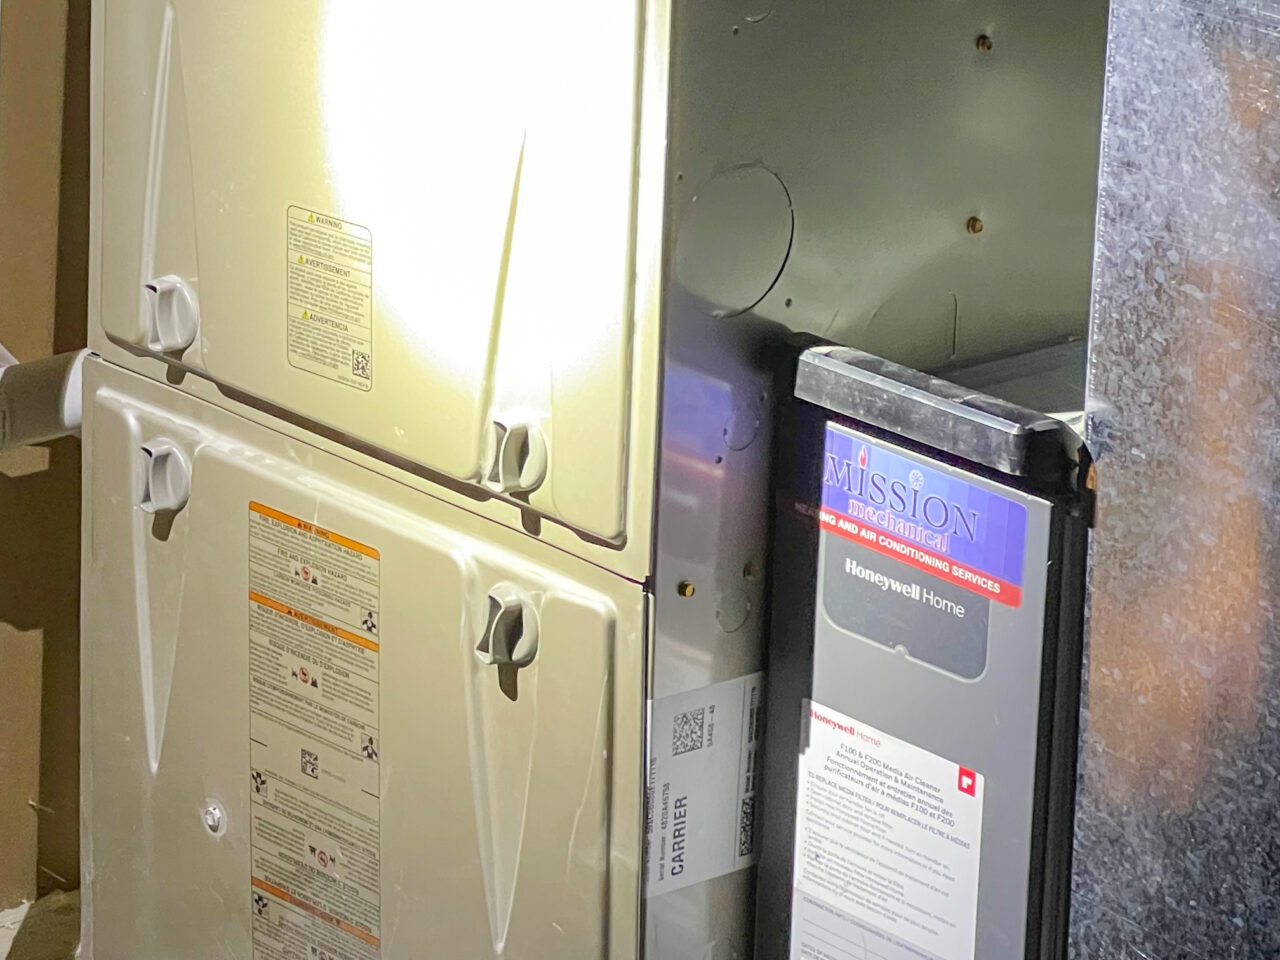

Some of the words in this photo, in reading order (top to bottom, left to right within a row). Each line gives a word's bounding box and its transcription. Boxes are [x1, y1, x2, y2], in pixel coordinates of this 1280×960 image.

[316, 216, 343, 230] WARNING
[305, 257, 351, 278] AVERTISSEMENT
[309, 313, 349, 333] ADVERTENCIA
[824, 448, 979, 543] MISSION
[848, 498, 951, 553] mechanical
[838, 519, 859, 534] AND
[860, 528, 877, 542] AIR
[878, 535, 950, 573] CONDITIONING
[952, 564, 1001, 595] SERVICES
[845, 557, 920, 601] Honeywell
[923, 587, 965, 618] Home
[809, 707, 855, 737] Honeywell
[856, 727, 881, 748] Home
[827, 756, 878, 784] Fonctionnement
[941, 807, 953, 818] des
[837, 751, 859, 764] Annual
[860, 760, 893, 780] Operation
[900, 779, 944, 803] Maintenance
[841, 744, 857, 756] F100
[865, 754, 881, 767] F200
[882, 762, 903, 776] Media
[915, 776, 941, 793] Cleaner
[670, 795, 688, 877] CARRIER
[911, 802, 928, 816] F100
[937, 814, 955, 827] F200
